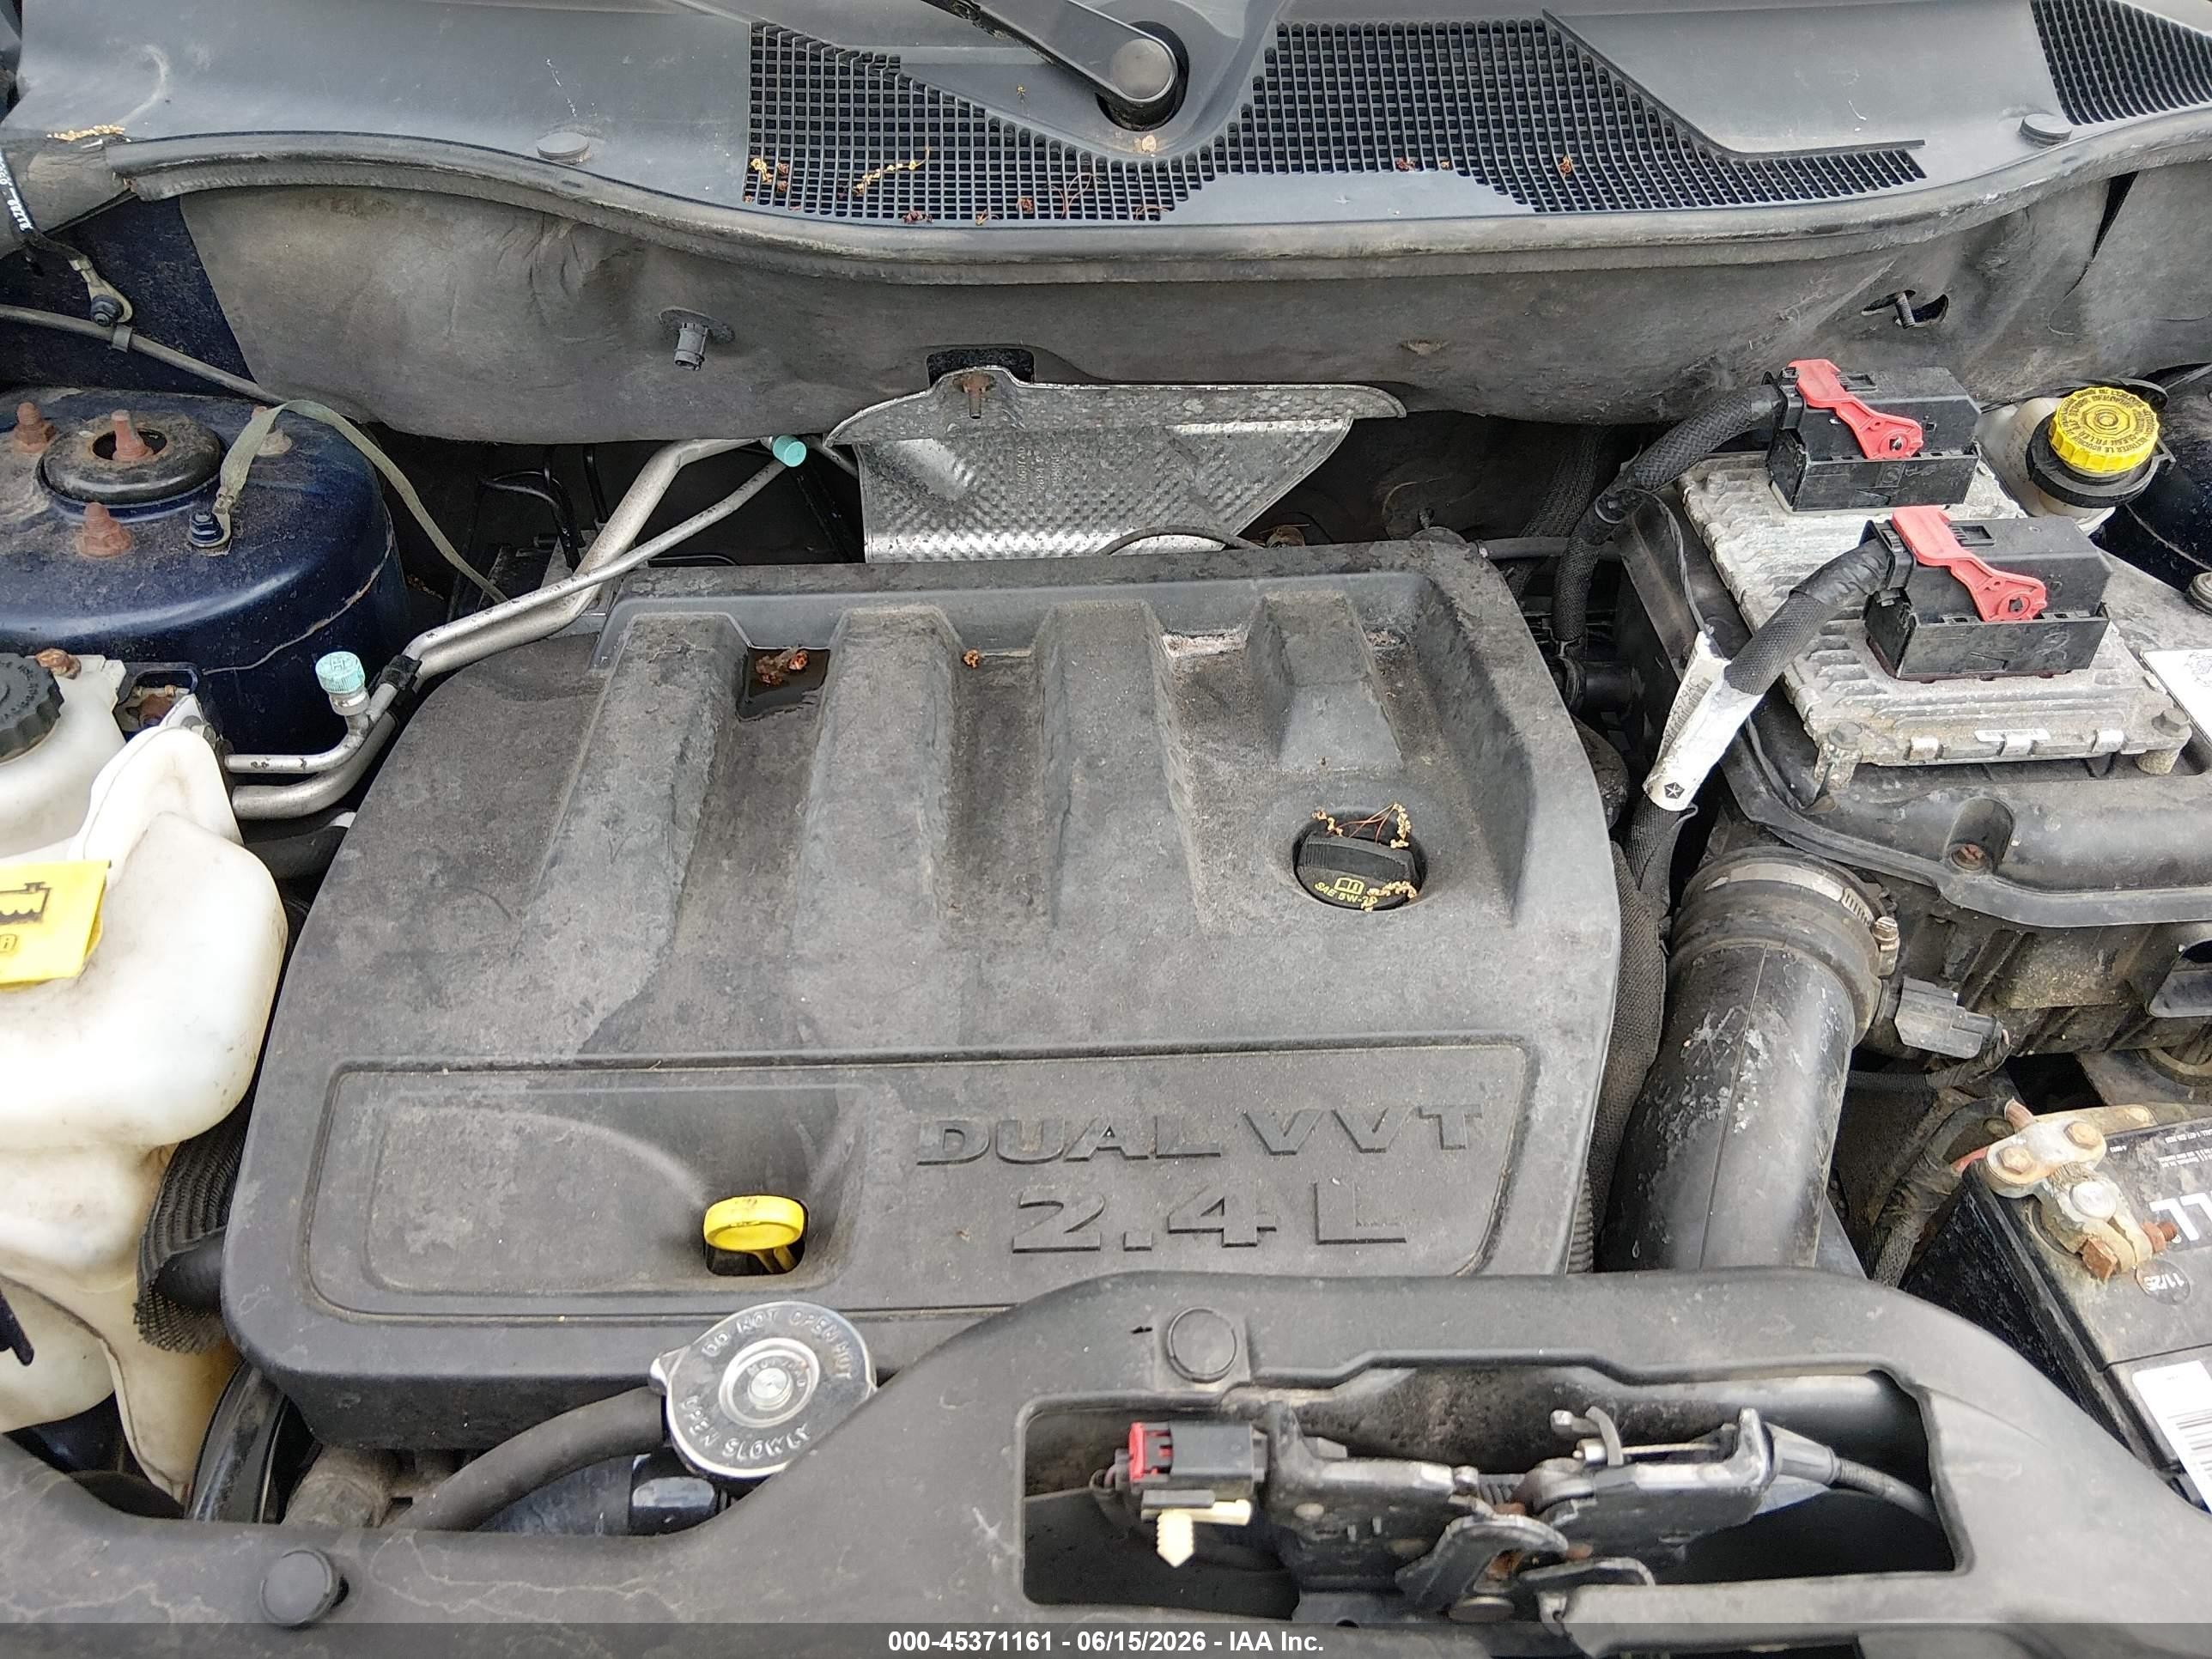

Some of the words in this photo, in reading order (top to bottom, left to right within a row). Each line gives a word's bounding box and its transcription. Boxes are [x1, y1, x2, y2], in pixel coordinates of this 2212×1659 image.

[1314, 881, 1338, 897] SAE
[915, 1116, 1221, 1166] DUAL
[1245, 1105, 1483, 1156] VVT
[702, 1332, 730, 1357] DO
[736, 1310, 779, 1334] NOT
[789, 1310, 840, 1342] OPEN
[721, 1423, 812, 1461] SLOWLY
